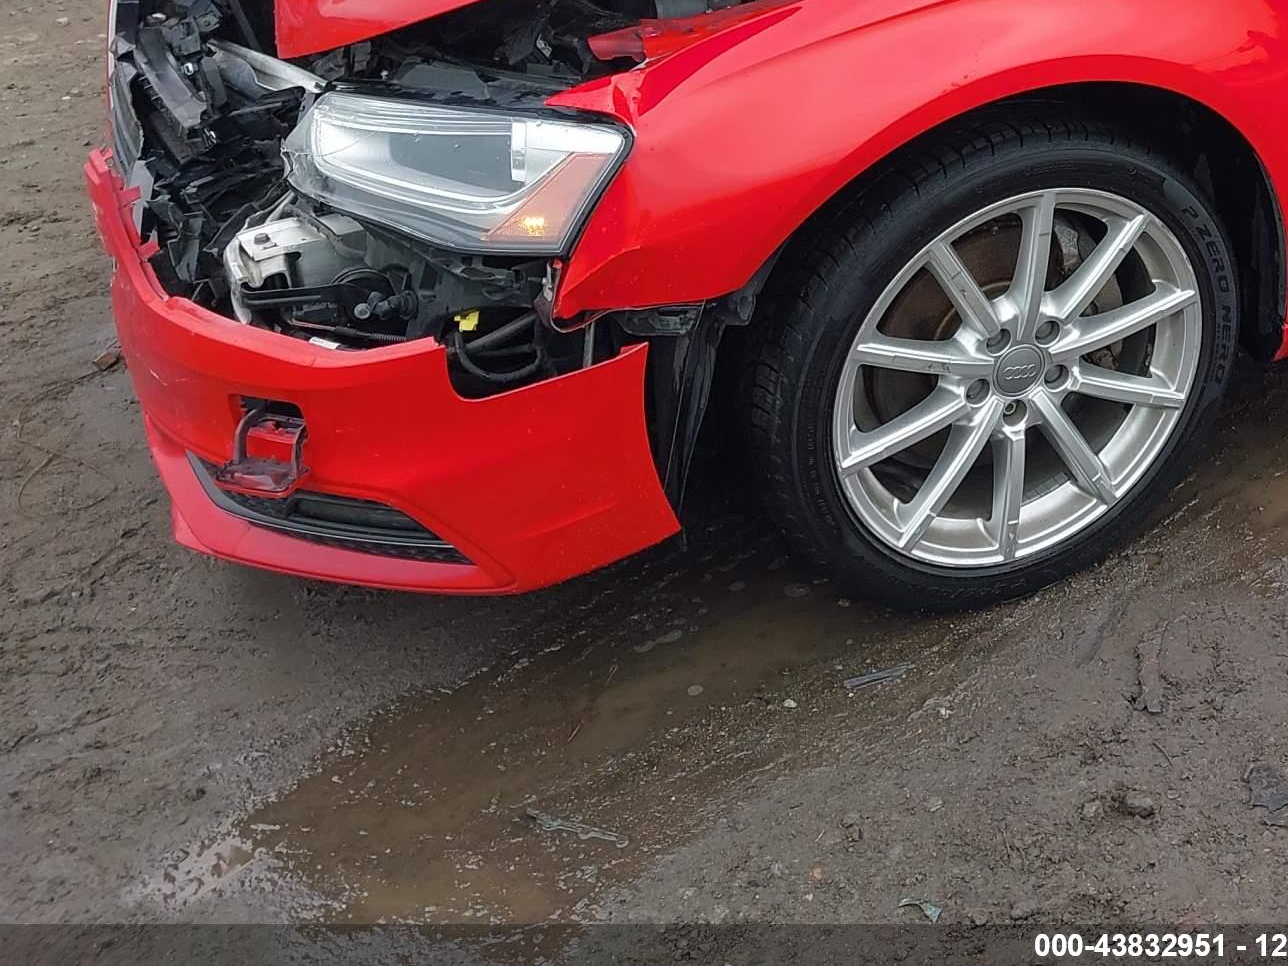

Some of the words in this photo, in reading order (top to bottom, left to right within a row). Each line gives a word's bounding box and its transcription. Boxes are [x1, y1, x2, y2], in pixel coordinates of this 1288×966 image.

[1181, 205, 1199, 220] P
[1195, 224, 1230, 293] ZERO
[1215, 303, 1233, 385] NERO
